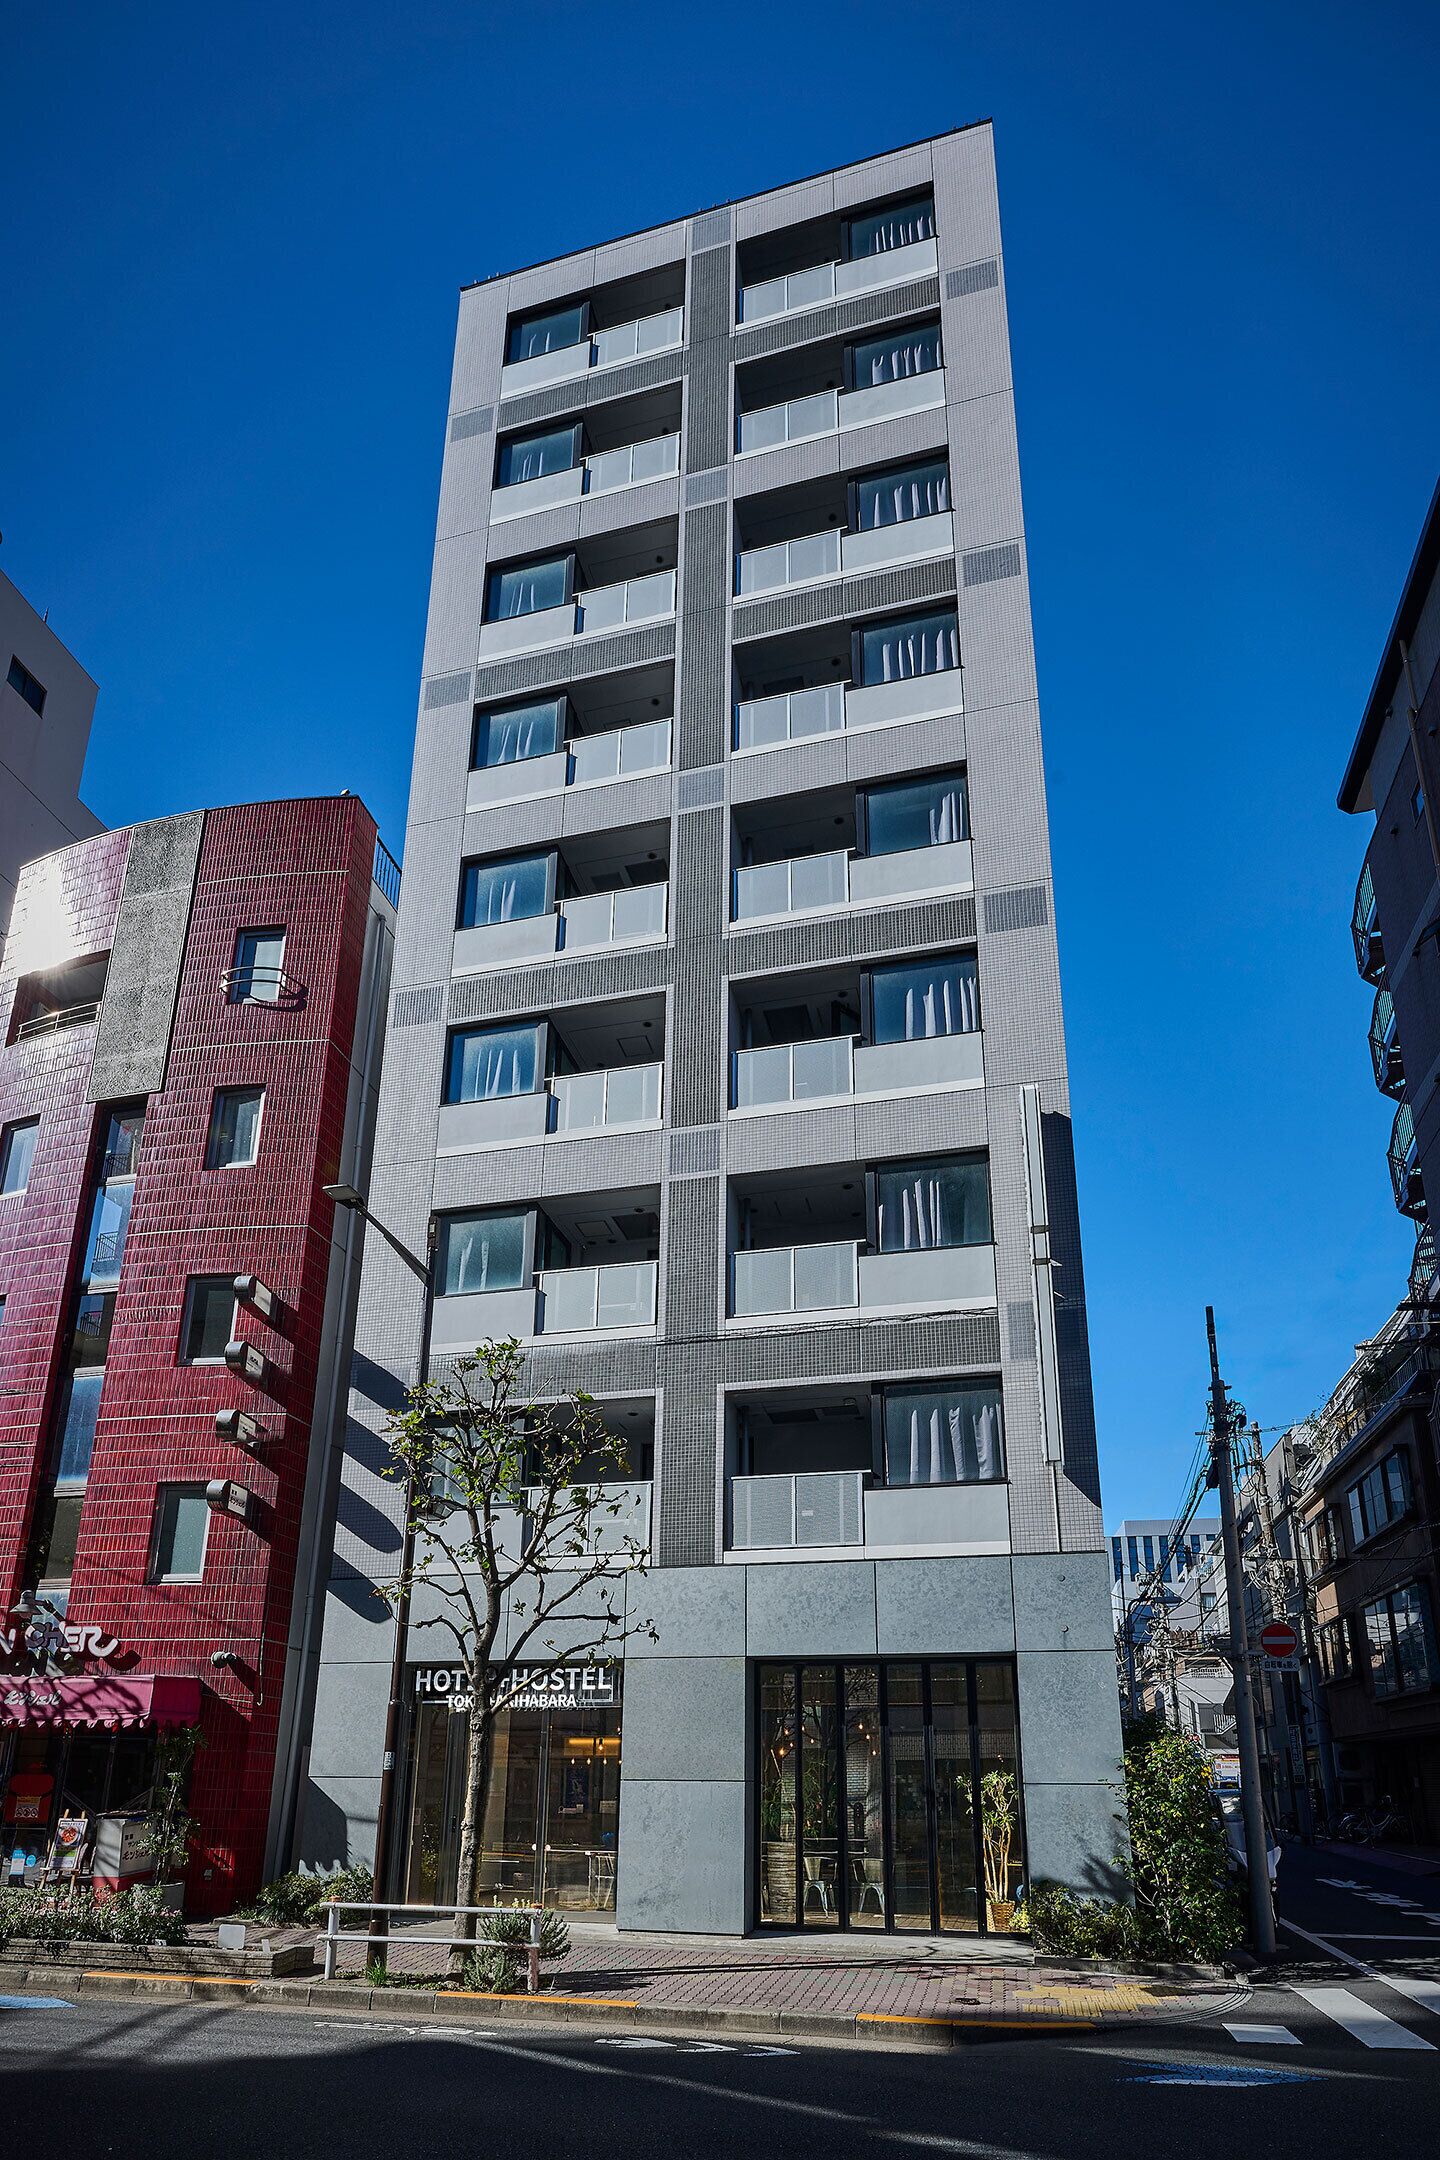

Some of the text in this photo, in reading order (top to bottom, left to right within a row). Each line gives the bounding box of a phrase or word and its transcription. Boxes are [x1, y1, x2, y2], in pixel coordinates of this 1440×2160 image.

[415, 1668, 484, 1692] HOT
[511, 1667, 612, 1691] HOSTEL
[445, 1694, 492, 1708] TOK
